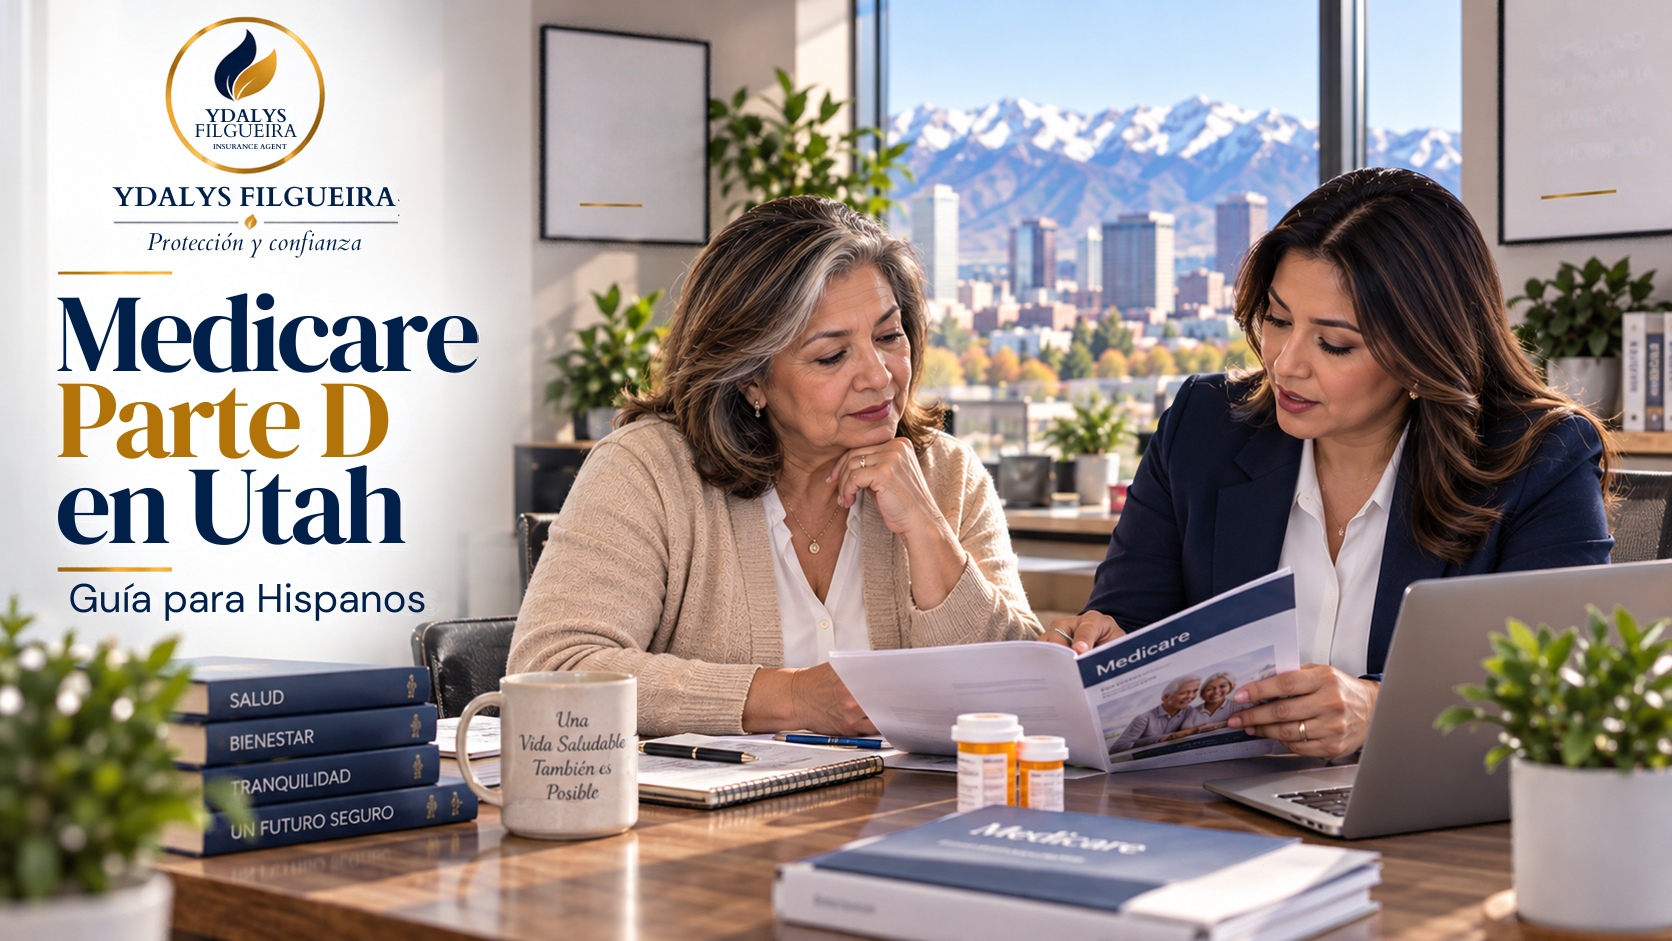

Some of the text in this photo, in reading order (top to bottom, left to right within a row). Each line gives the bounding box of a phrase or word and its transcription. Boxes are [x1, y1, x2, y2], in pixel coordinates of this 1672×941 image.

[1095, 630, 1191, 677] Medicare
[229, 689, 285, 709] SALUD
[555, 711, 590, 728] Una
[229, 728, 315, 752] BIENESTAR
[518, 732, 627, 753] Vida Saludable
[532, 758, 613, 777] También es
[230, 768, 352, 798] TRANQUILIDAD
[546, 782, 600, 802] Posible
[230, 804, 395, 840] UN FUTURO SEGURO
[968, 821, 1147, 855] Medicare
